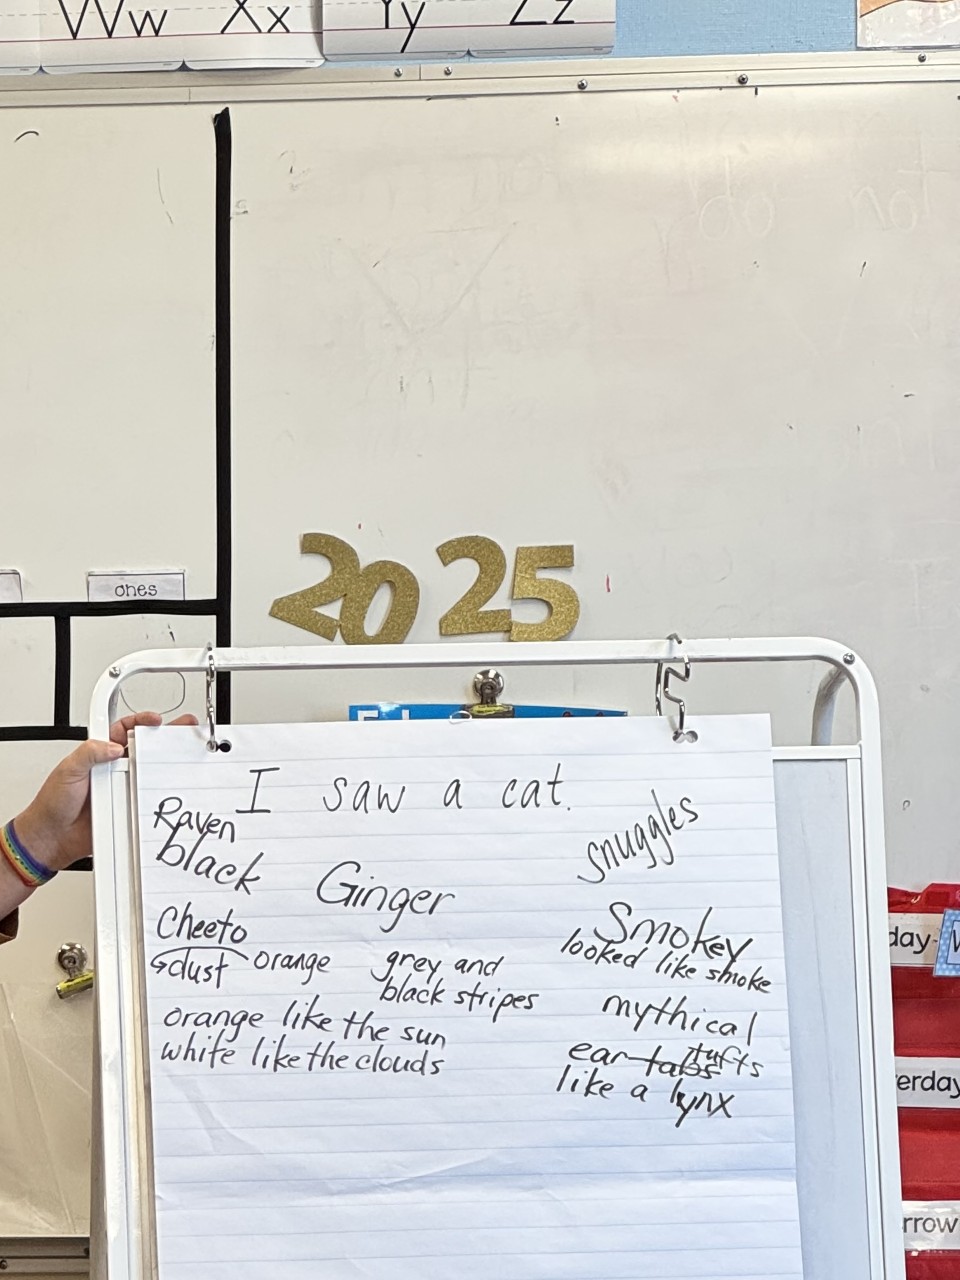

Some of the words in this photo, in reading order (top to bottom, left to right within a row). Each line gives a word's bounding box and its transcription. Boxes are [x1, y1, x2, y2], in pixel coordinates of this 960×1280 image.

[58, 0, 168, 40] Ww
[220, 0, 291, 34] Xx
[114, 581, 159, 598] ones
[268, 532, 581, 646] 2025
[235, 766, 281, 814] I
[322, 777, 407, 814] saw
[442, 778, 463, 810] a
[153, 796, 236, 844] Raven
[155, 822, 265, 896] black
[316, 861, 456, 934] Ginger
[156, 902, 248, 945] Cheeto
[593, 901, 754, 972] Smokey
[167, 947, 229, 989] dust
[252, 950, 332, 986] orange
[370, 949, 442, 985] grey
[453, 955, 504, 977] and
[560, 927, 649, 969] looked
[655, 950, 697, 979] like
[705, 965, 772, 993] smoke
[163, 1005, 264, 1043] orange
[282, 994, 332, 1033] like
[342, 1010, 390, 1042] the
[399, 1027, 447, 1050] sun
[379, 976, 445, 1006] black
[453, 982, 540, 1023] stripes
[602, 994, 758, 1047] mythical
[160, 1029, 236, 1069] white
[251, 1034, 301, 1073] like
[306, 1041, 349, 1071] the
[355, 1044, 445, 1076] clouds
[556, 1064, 615, 1099] like
[630, 1083, 648, 1102] a
[669, 1078, 736, 1128] lynx
[895, 1070, 960, 1099] erday
[903, 1217, 959, 1233] rrow
